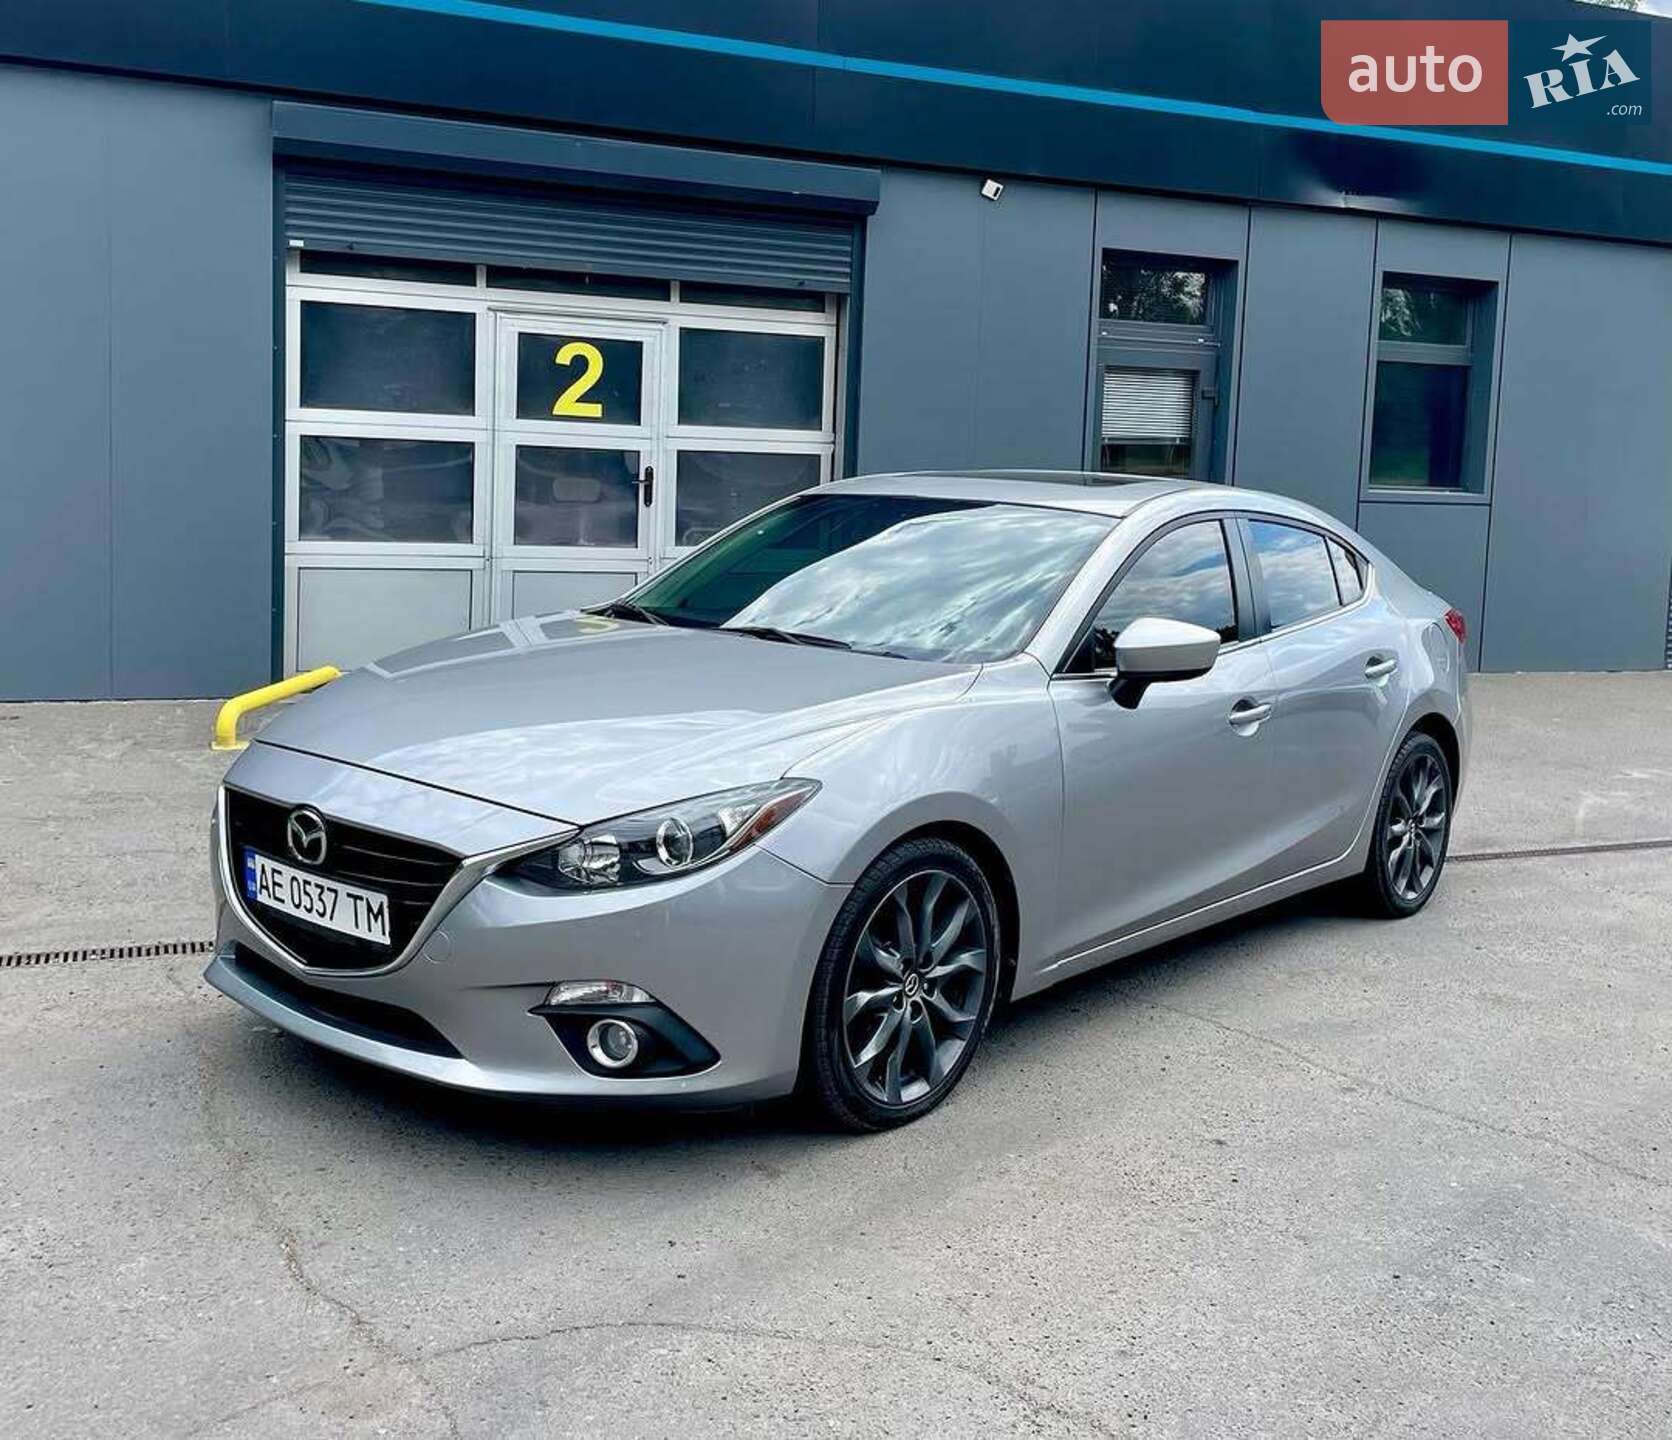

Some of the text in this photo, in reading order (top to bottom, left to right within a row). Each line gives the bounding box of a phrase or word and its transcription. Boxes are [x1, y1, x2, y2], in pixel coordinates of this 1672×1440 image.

[552, 342, 603, 417] 2
[259, 864, 386, 936] AE 0537 TM
